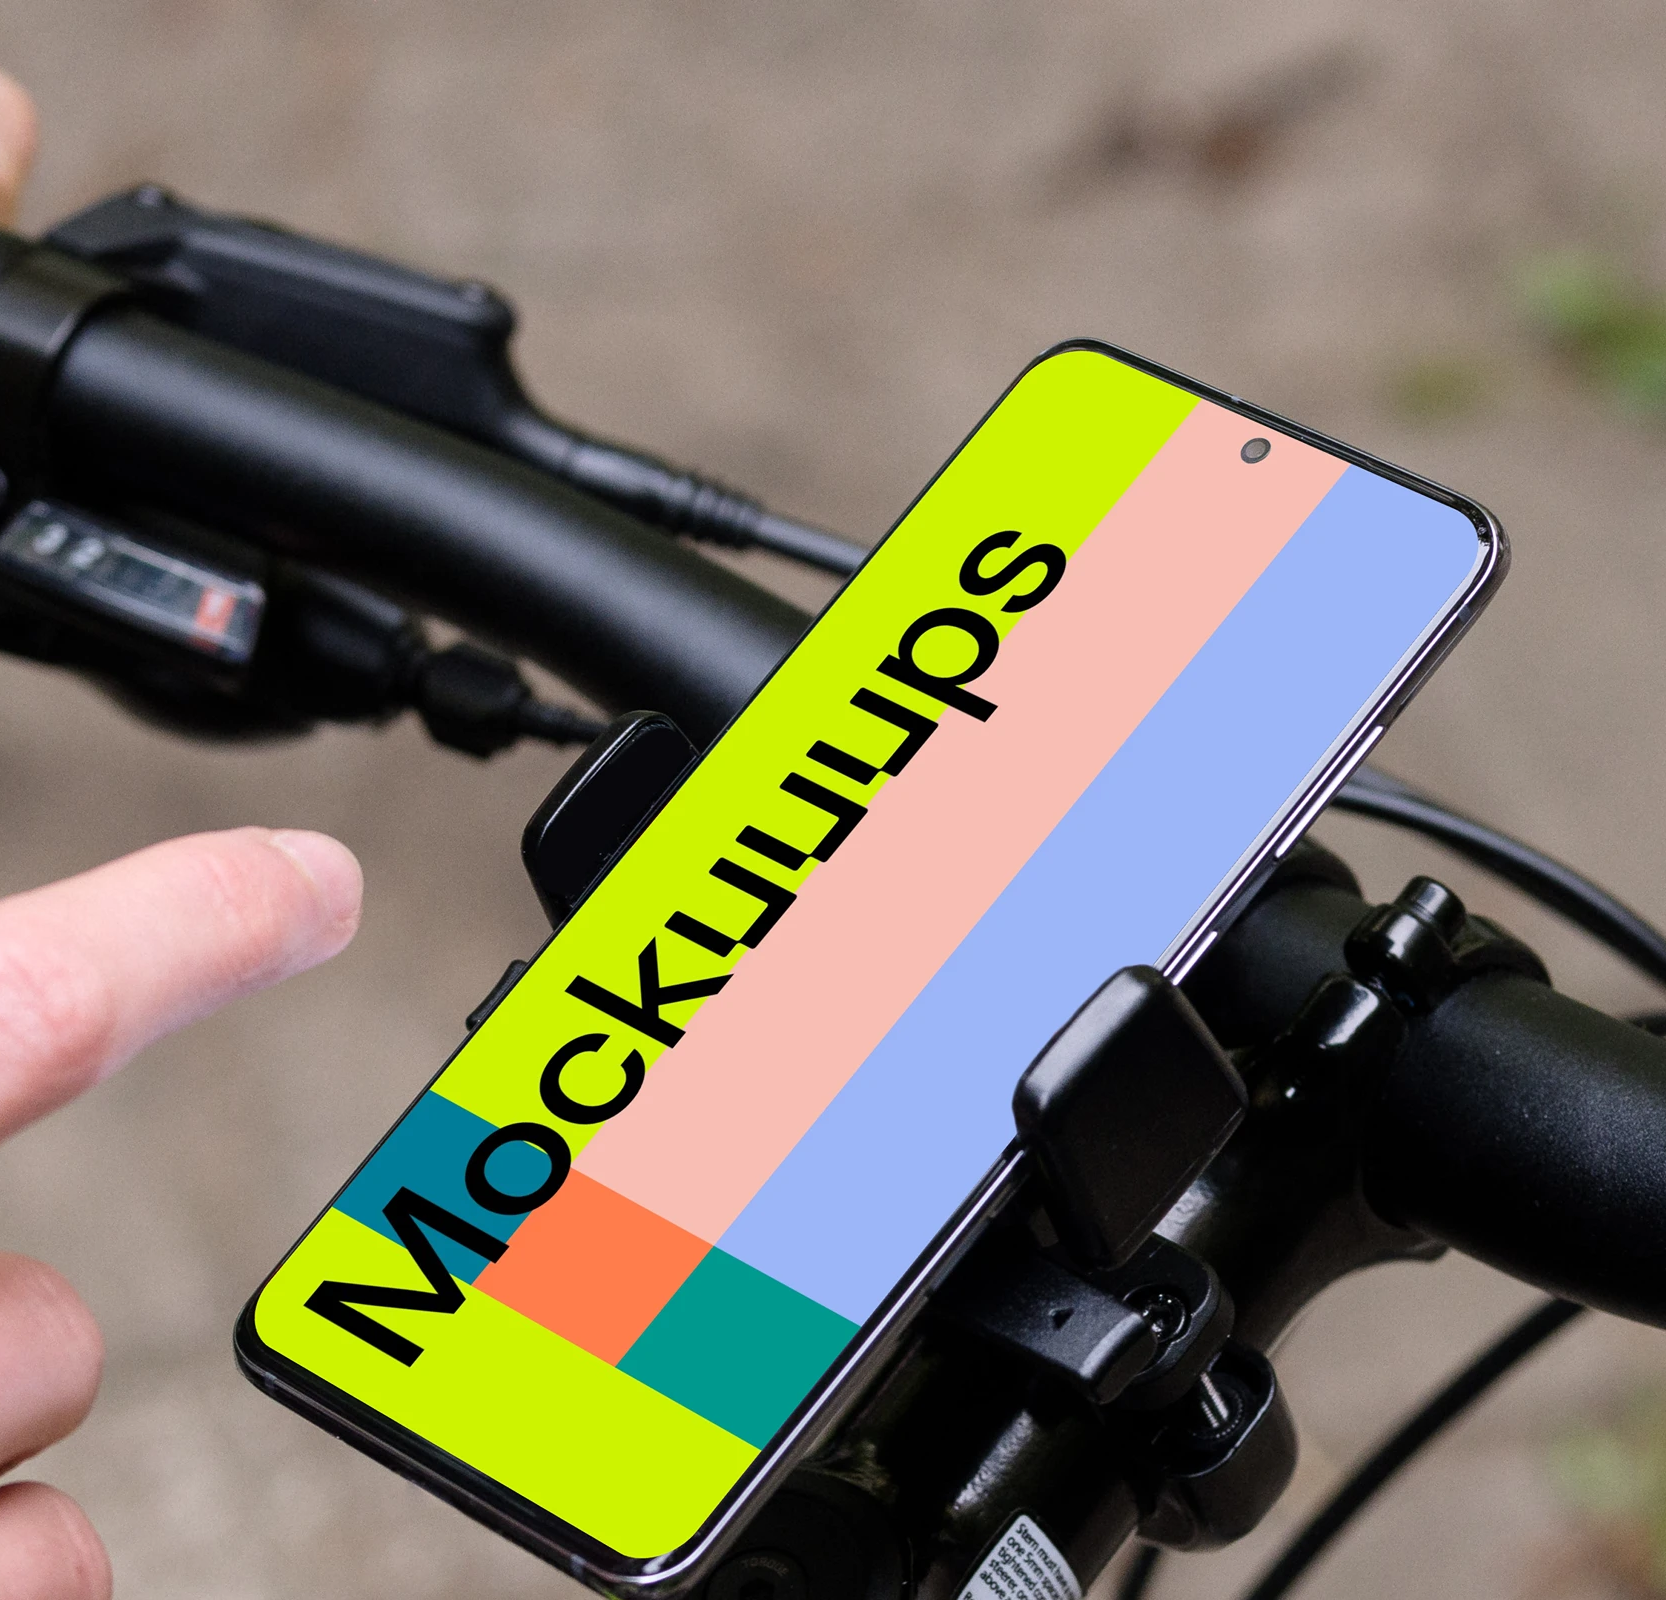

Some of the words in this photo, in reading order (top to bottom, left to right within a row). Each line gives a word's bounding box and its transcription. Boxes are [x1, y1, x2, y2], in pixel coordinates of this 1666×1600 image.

[304, 531, 1066, 1367] Mockuuups
[740, 1555, 789, 1577] TORQUE
[997, 1546, 1038, 1591] tightened
[1006, 1536, 1026, 1557] one
[1023, 1552, 1045, 1580] 5mm
[1015, 1523, 1039, 1551] Stem
[1037, 1548, 1057, 1572] must
[979, 1570, 1006, 1600] above
[988, 1559, 1018, 1594] steerer,
